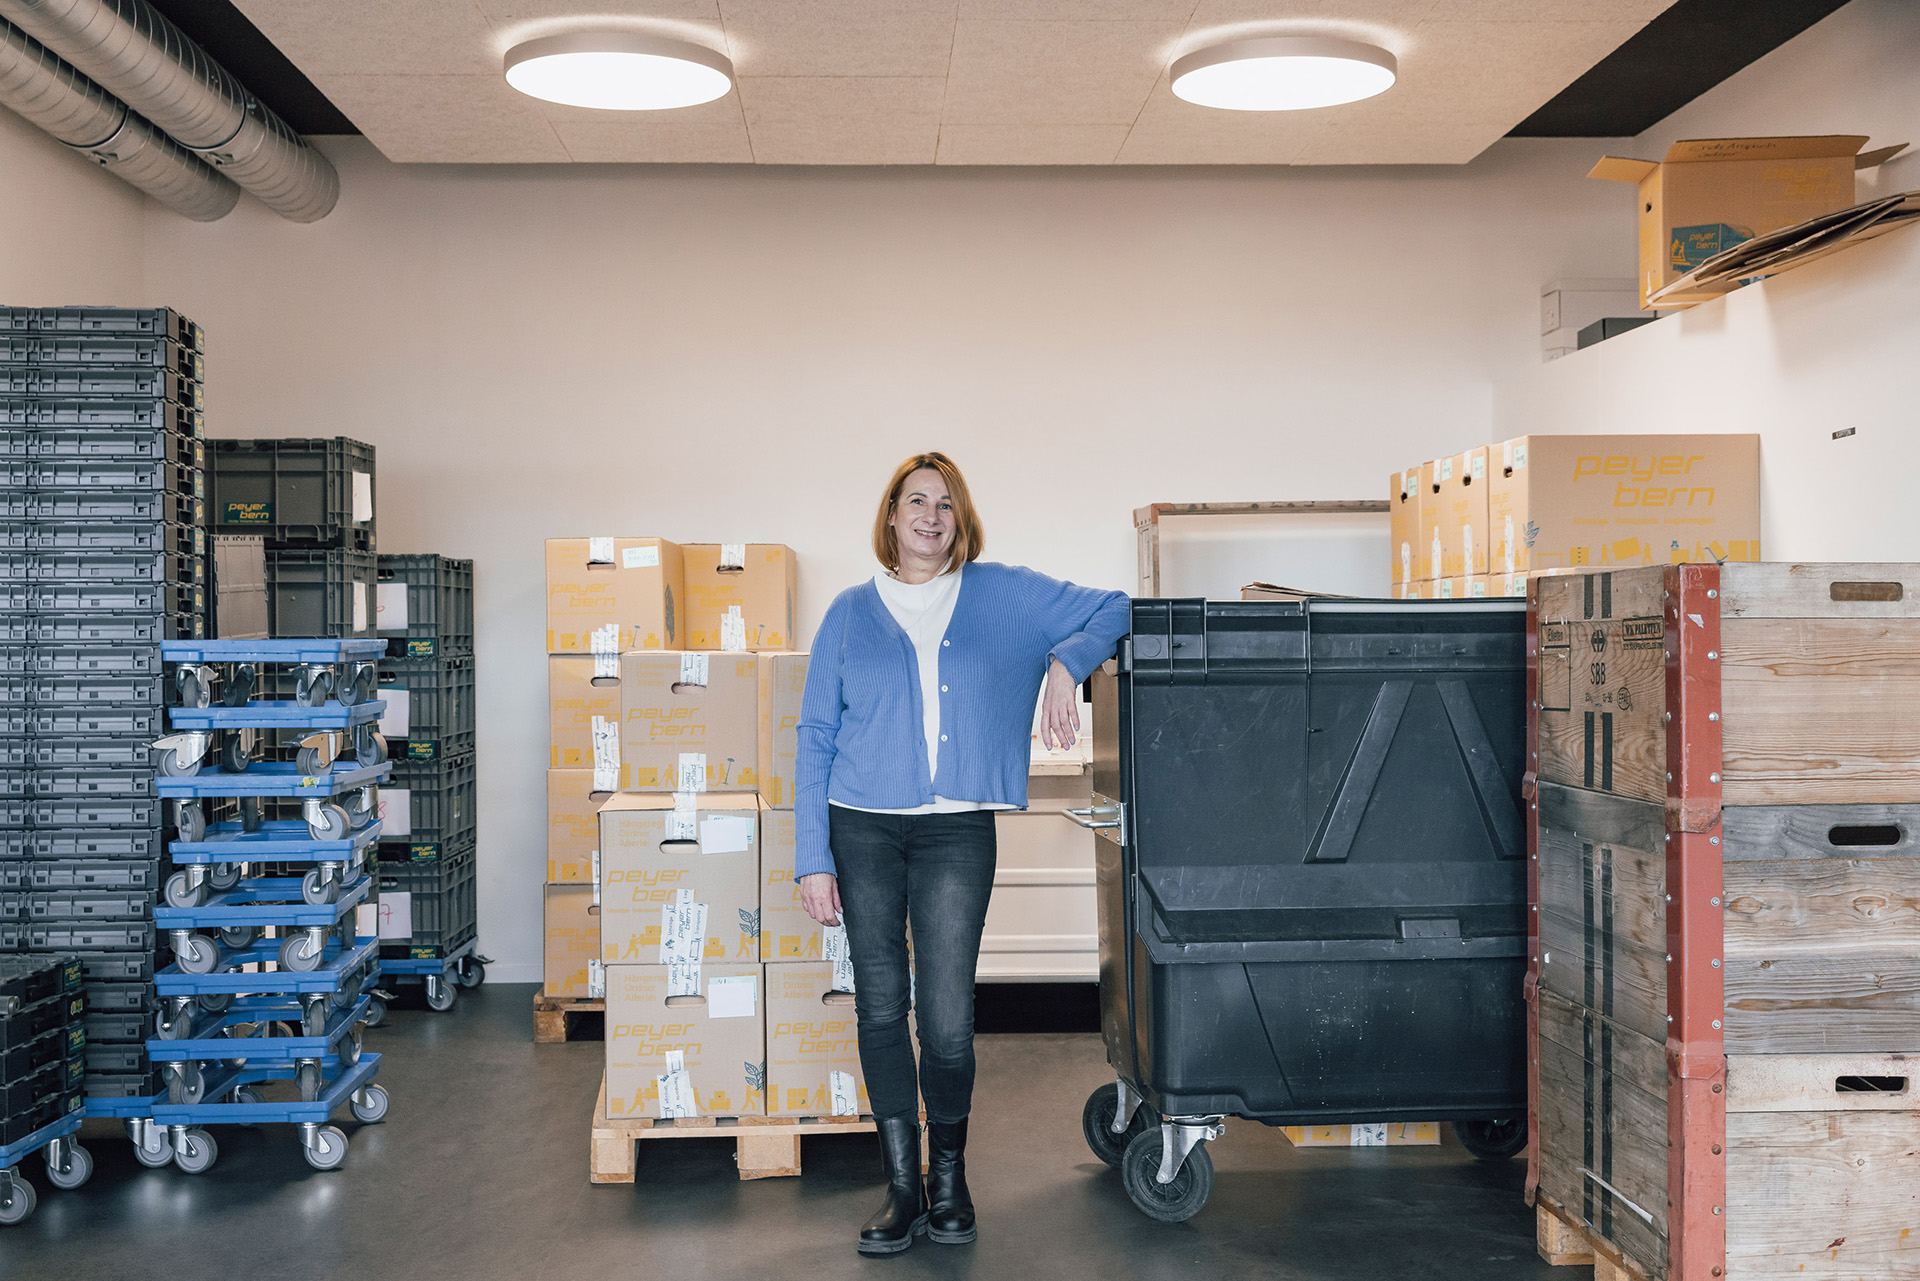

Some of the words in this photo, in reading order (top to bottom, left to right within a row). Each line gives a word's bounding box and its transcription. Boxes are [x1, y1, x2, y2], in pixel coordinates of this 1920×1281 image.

[1689, 232, 1717, 242] peyer
[1696, 240, 1719, 250] bern
[1572, 456, 1705, 482] peyer
[1613, 481, 1716, 507] bern
[228, 503, 266, 512] peyer
[239, 510, 270, 519] bern
[550, 583, 611, 596] peyer
[683, 585, 739, 597] peyer
[569, 595, 617, 607] bern
[1590, 662, 1606, 685] SBB
[554, 698, 615, 711] peyer
[573, 711, 621, 723] ben
[627, 707, 700, 723] peyer
[649, 721, 706, 736] bern
[552, 814, 598, 826] peye
[571, 826, 598, 838] be
[606, 869, 689, 887] peyer
[632, 886, 696, 902] ber
[549, 928, 600, 940] peye
[568, 939, 600, 952] ber
[612, 1023, 696, 1042] peyer
[773, 1020, 854, 1040] peyer
[637, 1040, 702, 1056] bern
[799, 1038, 859, 1054] bern
